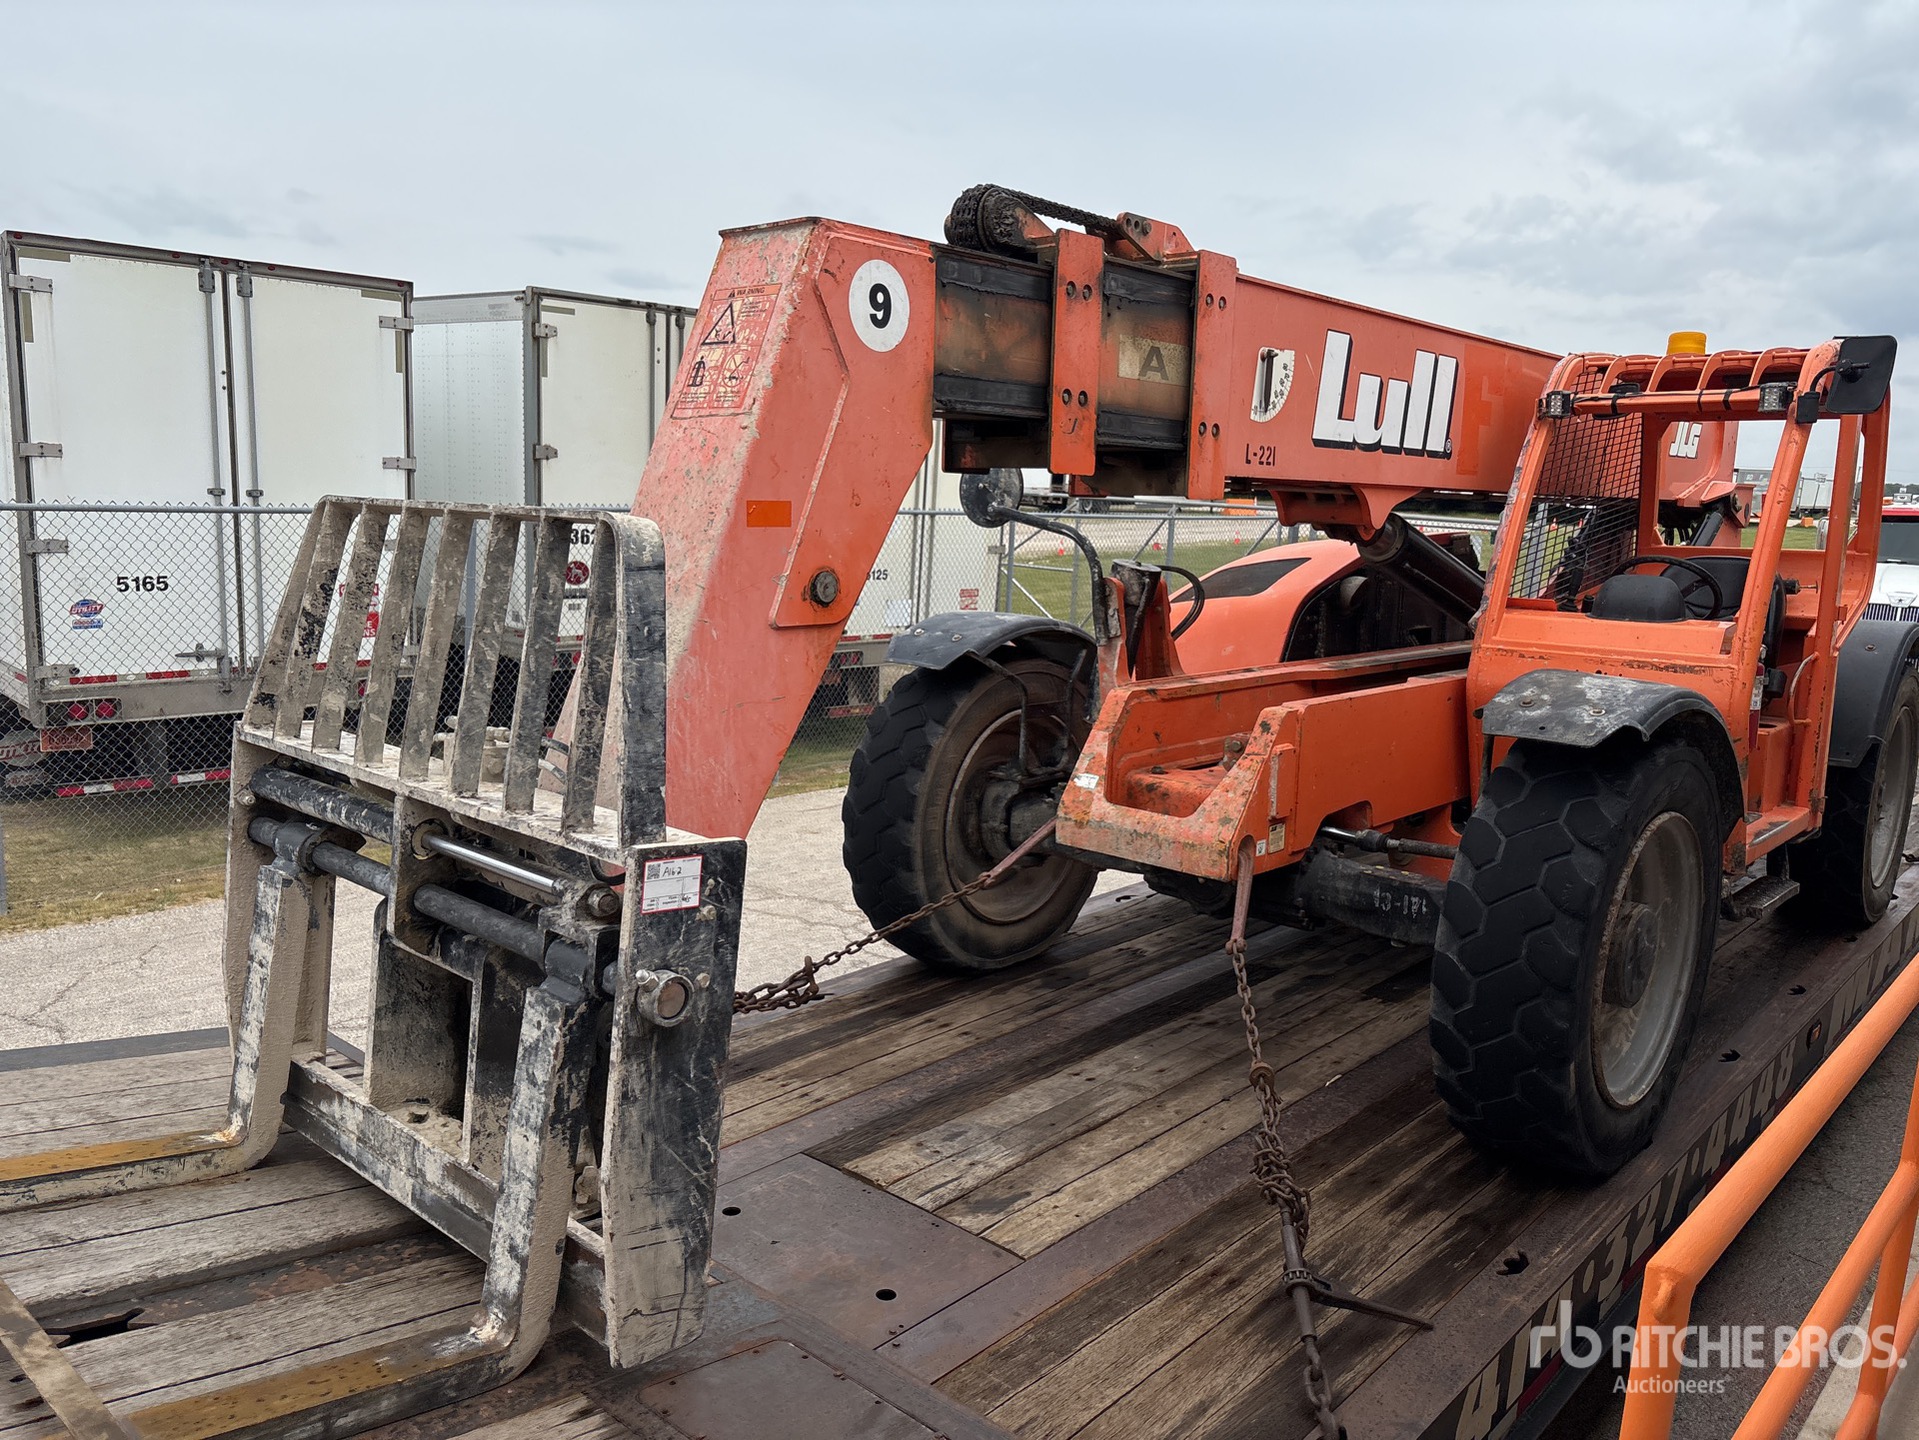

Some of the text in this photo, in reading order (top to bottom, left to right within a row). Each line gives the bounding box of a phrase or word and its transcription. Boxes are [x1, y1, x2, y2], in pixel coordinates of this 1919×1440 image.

[869, 283, 892, 329] 9
[1139, 346, 1170, 381] A
[1312, 329, 1458, 459] Lull
[1669, 420, 1703, 459] JLG
[116, 576, 169, 592] 5165
[71, 603, 104, 615] UTILITY
